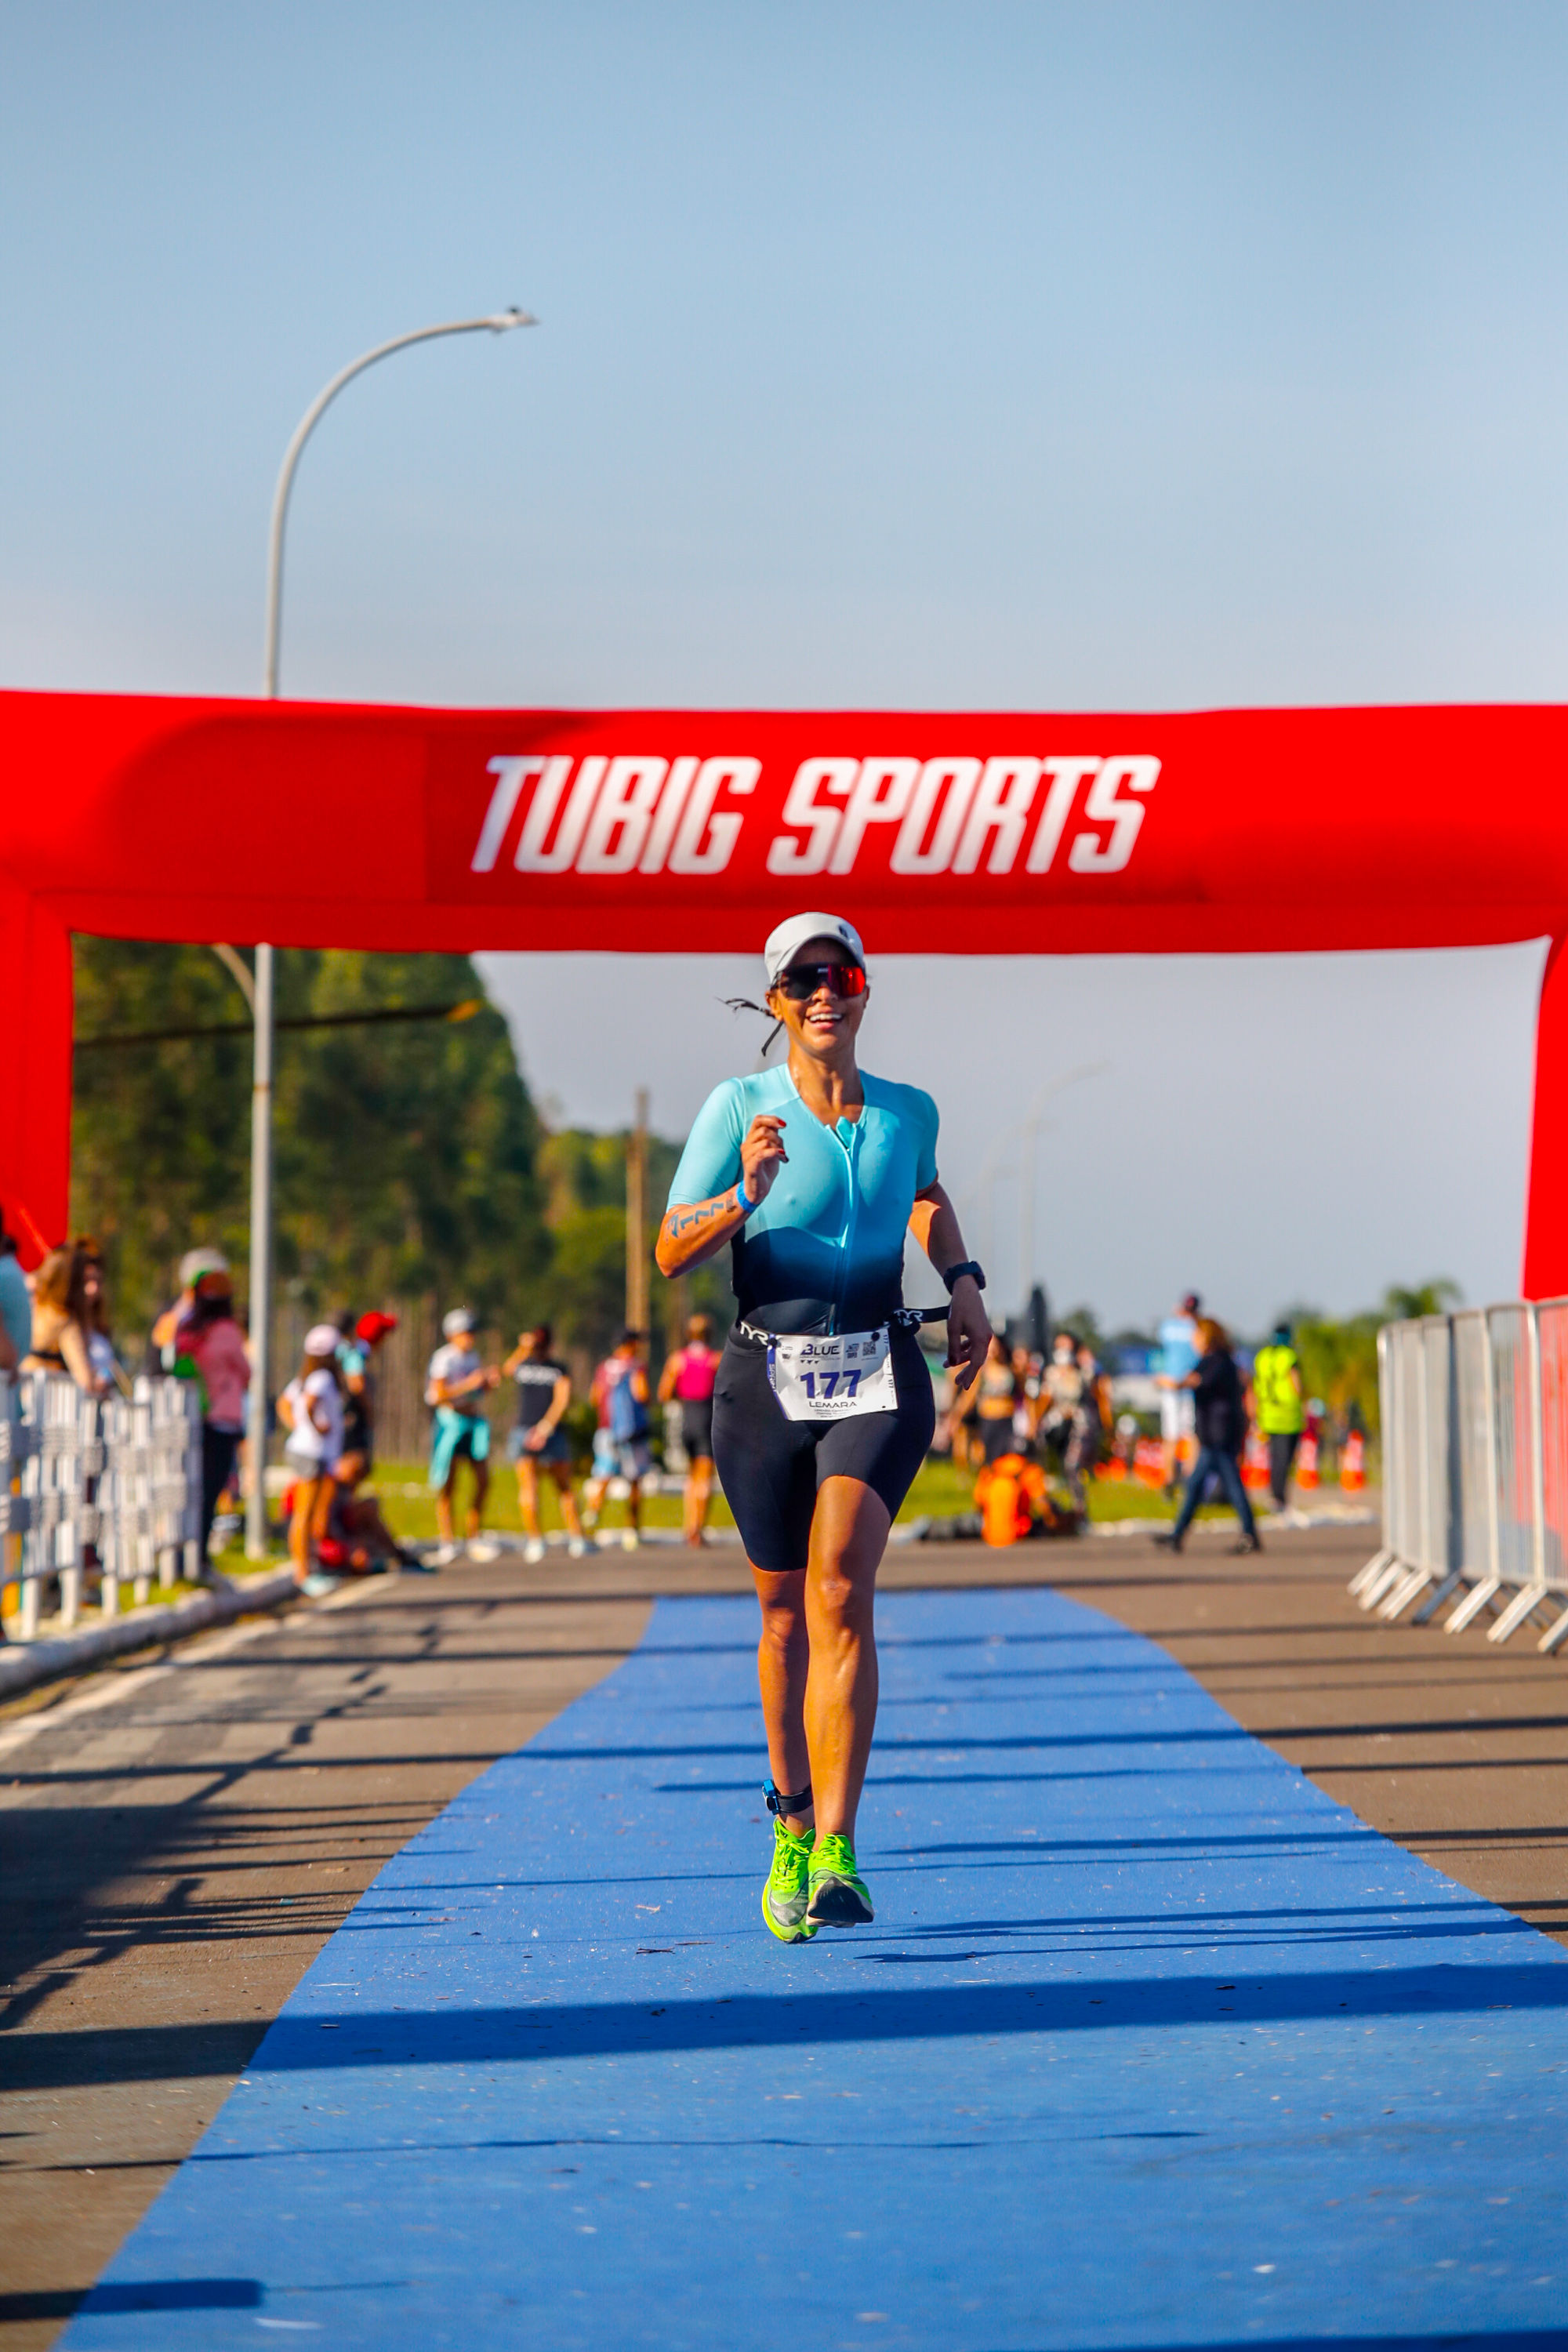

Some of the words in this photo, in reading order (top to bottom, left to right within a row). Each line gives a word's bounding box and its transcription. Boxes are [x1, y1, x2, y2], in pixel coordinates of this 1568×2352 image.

[470, 755, 763, 876] TUBIG
[766, 755, 1163, 877] SPORTS
[800, 1369, 862, 1399] 177
